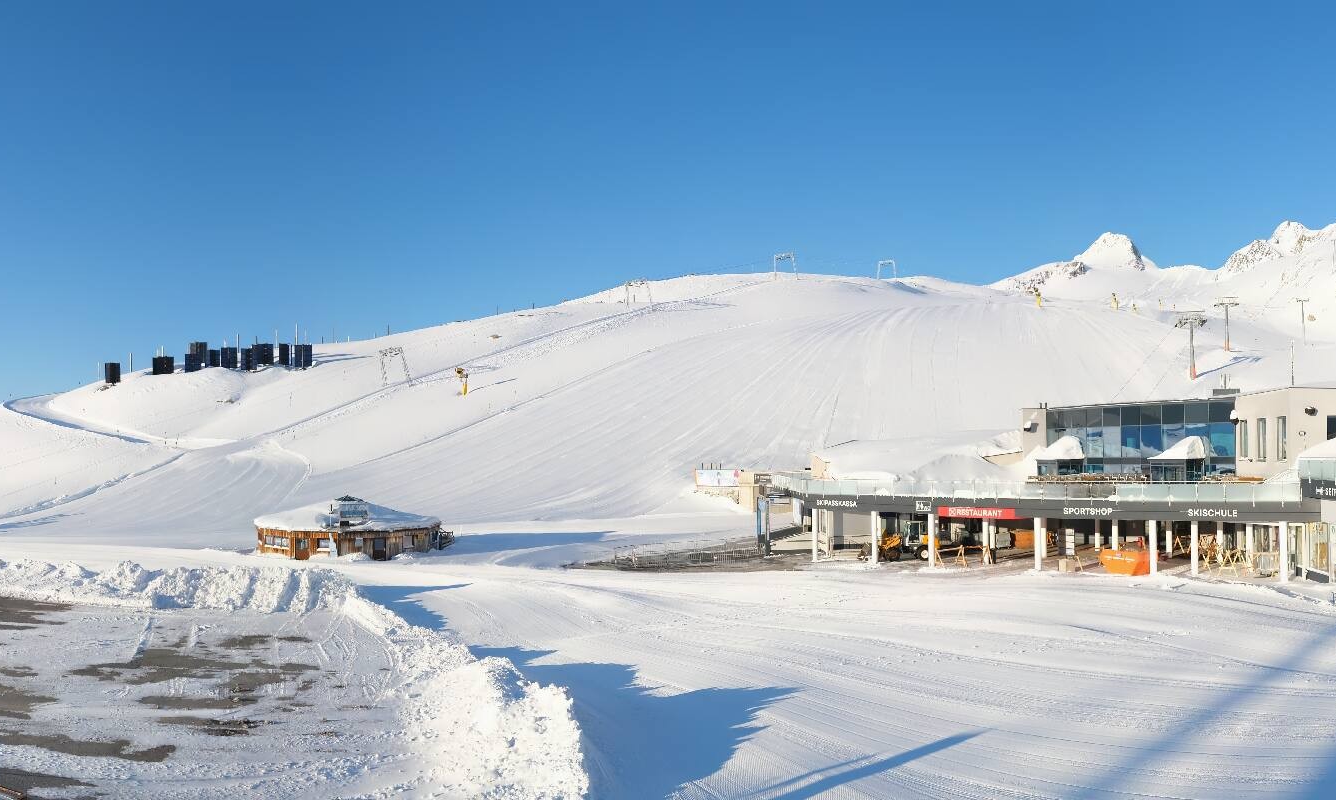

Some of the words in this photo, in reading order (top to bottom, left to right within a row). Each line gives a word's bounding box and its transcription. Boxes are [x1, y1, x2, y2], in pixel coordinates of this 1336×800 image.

[956, 507, 1003, 518] RESTAURANT
[1063, 507, 1113, 516] SPORTSHOP
[1187, 508, 1238, 518] SKISCHULE
